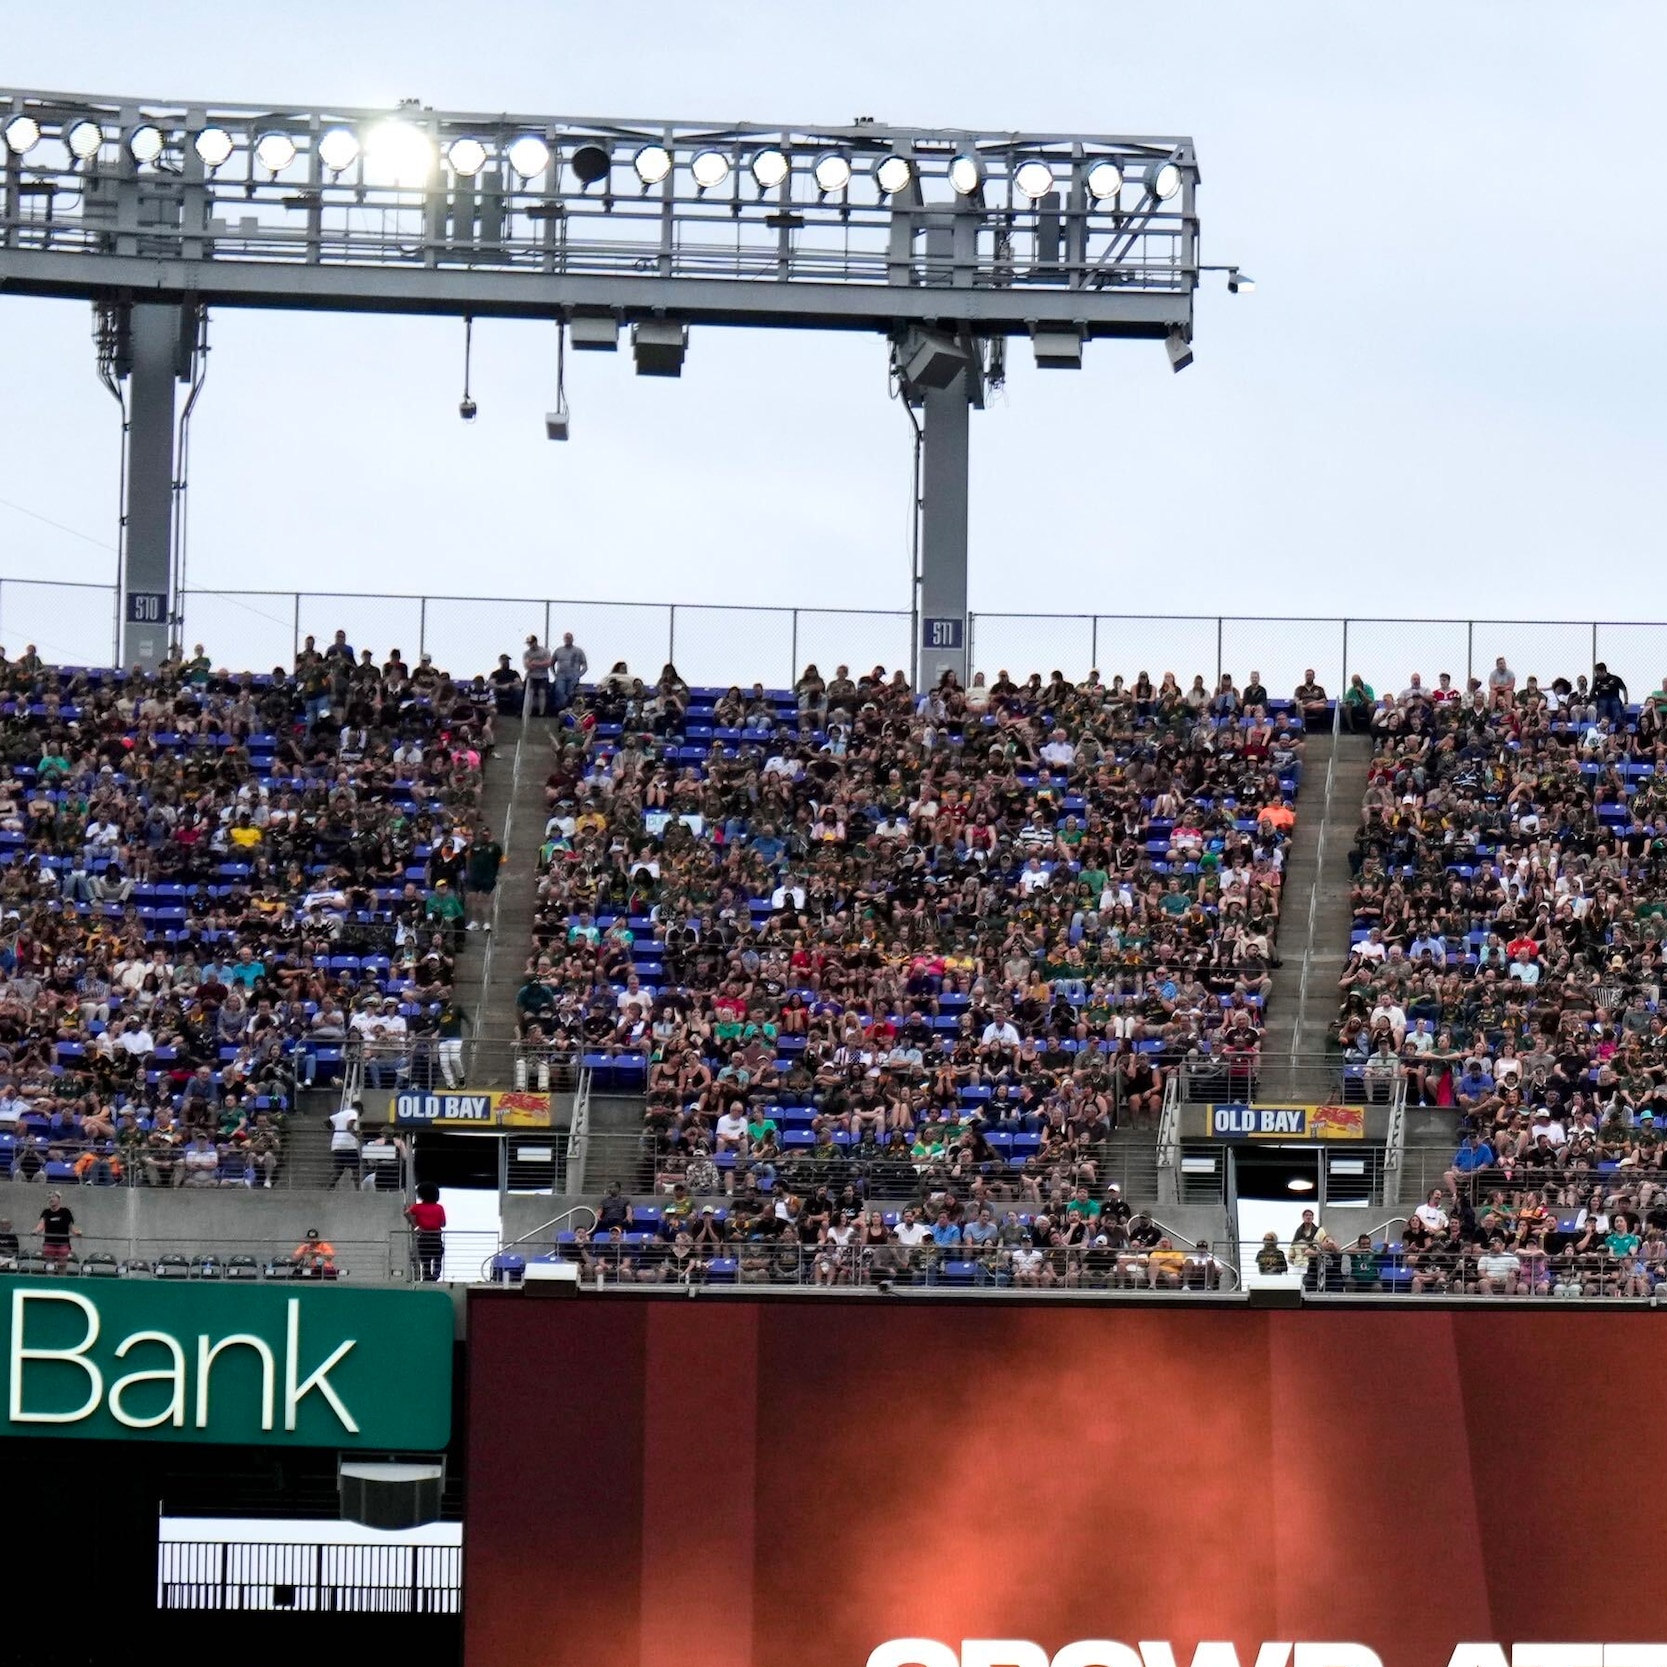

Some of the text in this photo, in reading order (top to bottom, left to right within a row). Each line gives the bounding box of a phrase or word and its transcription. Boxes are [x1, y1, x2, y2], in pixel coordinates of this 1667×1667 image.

[136, 596, 158, 620] 510
[933, 621, 953, 646] 511
[398, 1096, 486, 1119] OLD BAY
[1215, 1110, 1301, 1133] OLD BAY
[9, 1289, 359, 1432] Bank
